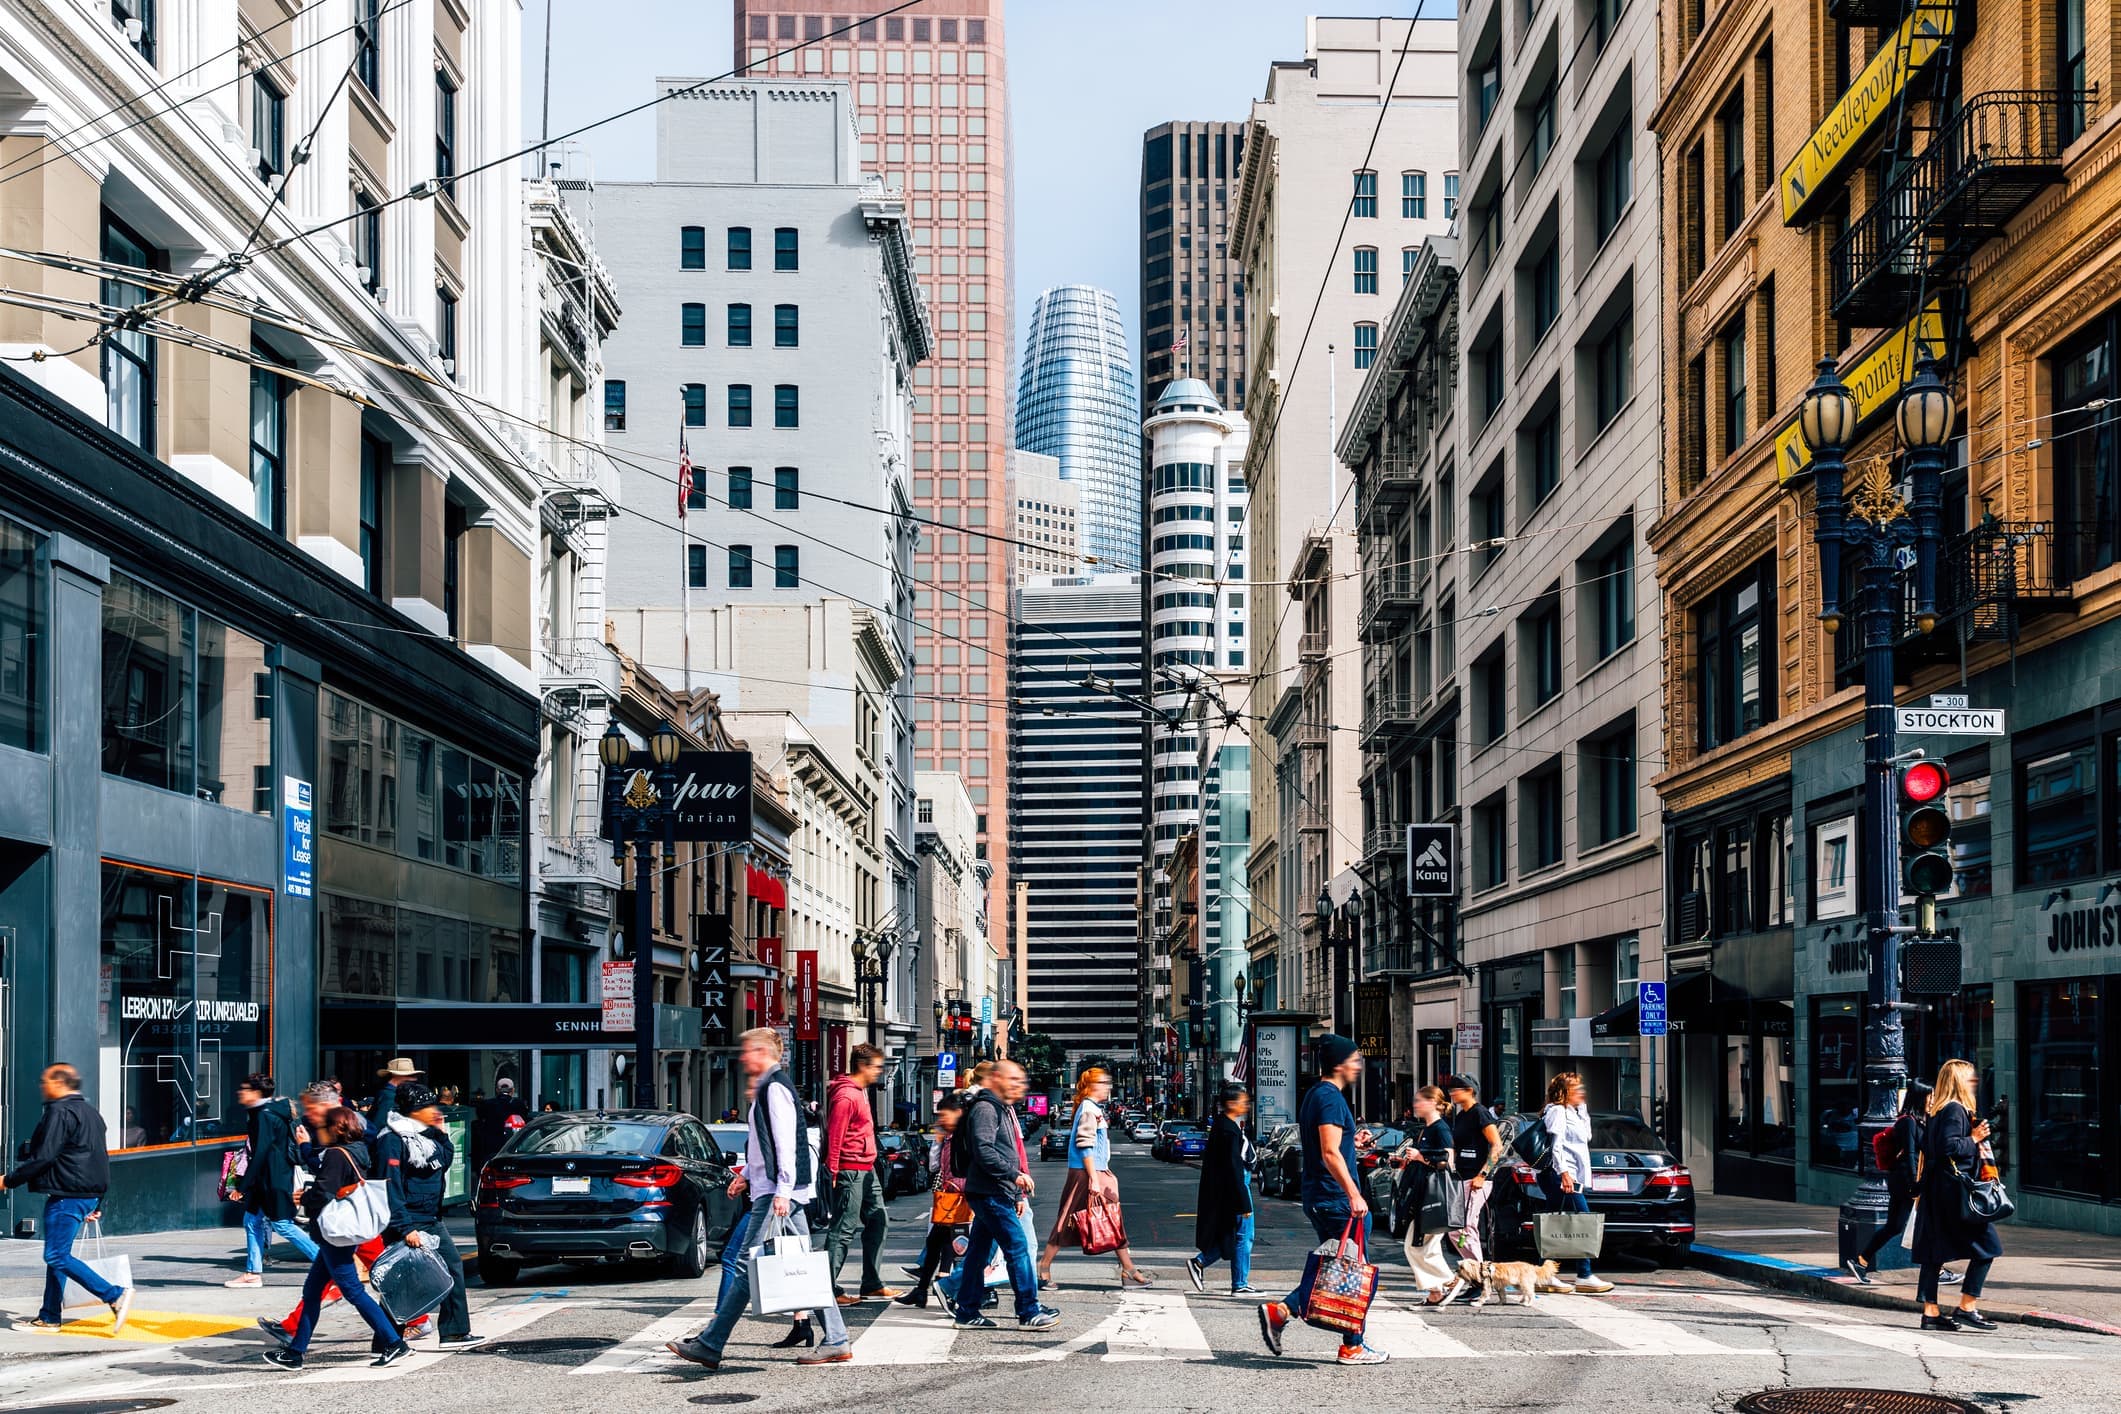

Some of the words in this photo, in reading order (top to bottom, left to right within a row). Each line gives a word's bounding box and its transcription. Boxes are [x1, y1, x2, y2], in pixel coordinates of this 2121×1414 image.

[1812, 55, 1900, 172] Needlepoin
[1946, 697, 1964, 706] 300
[1904, 713, 1994, 728] STOCKTON
[293, 815, 311, 834] Retail
[302, 834, 311, 850] for
[292, 844, 311, 865] Lease
[1416, 870, 1448, 883] Kong
[602, 967, 612, 976] NO
[700, 946, 727, 1029] ZARA
[122, 996, 161, 1018] LEBRON
[162, 999, 173, 1019] 17
[196, 1000, 211, 1020] AIR
[211, 1001, 259, 1022] UNRIVALED
[603, 1001, 613, 1010] NO
[1641, 1003, 1665, 1011] PARKING
[1645, 1011, 1660, 1020] ONLY
[1262, 1032, 1276, 1041] Lob
[1360, 1036, 1385, 1048] ART
[1258, 1047, 1272, 1057] APIs
[1258, 1058, 1279, 1069] Bring
[1258, 1067, 1287, 1078] Offline,
[1258, 1078, 1287, 1088] Online.
